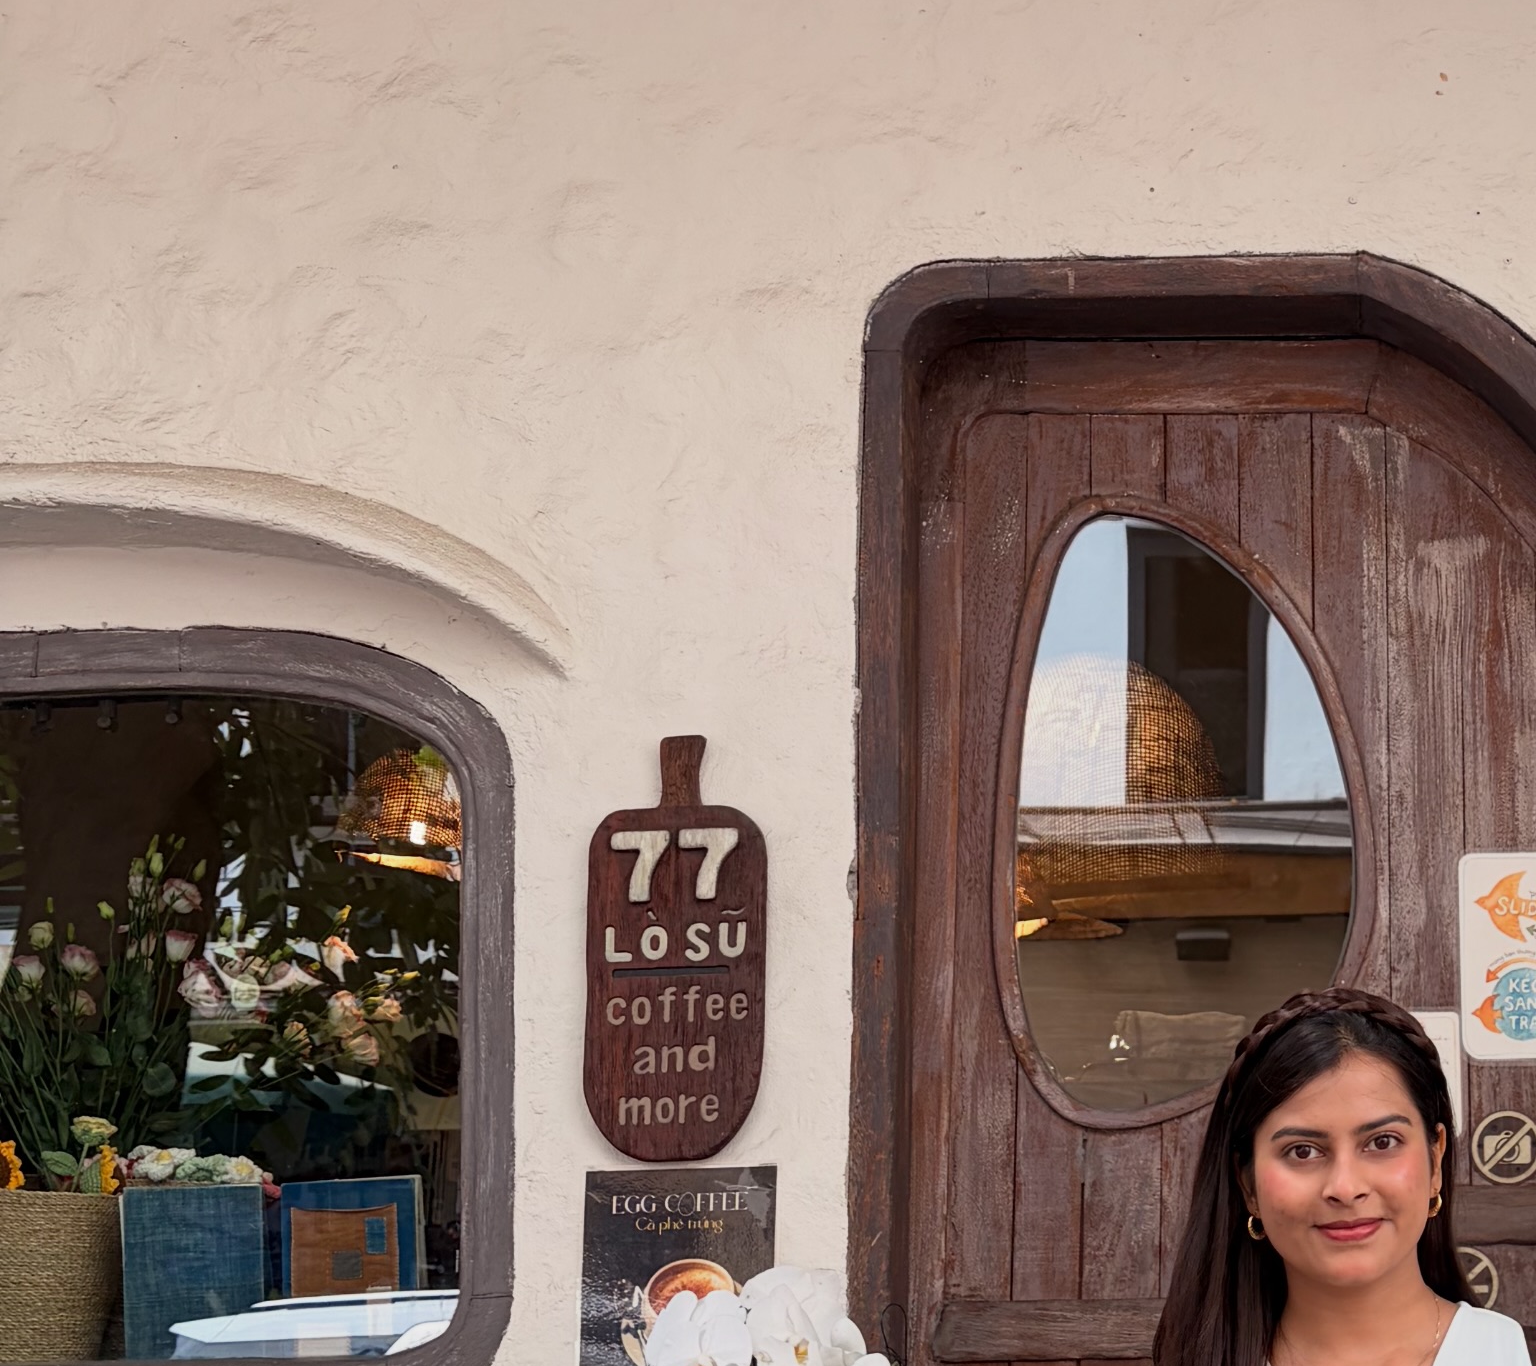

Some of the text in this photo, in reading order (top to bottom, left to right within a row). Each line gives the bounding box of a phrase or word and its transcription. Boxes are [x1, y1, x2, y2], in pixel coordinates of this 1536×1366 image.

[610, 827, 739, 903] 77
[605, 907, 748, 963] LÒ SŨ
[606, 985, 748, 1026] coffee
[633, 1036, 717, 1075] and
[618, 1092, 720, 1126] more
[611, 1191, 749, 1216] EGG COFFEE
[635, 1216, 656, 1231] Cà
